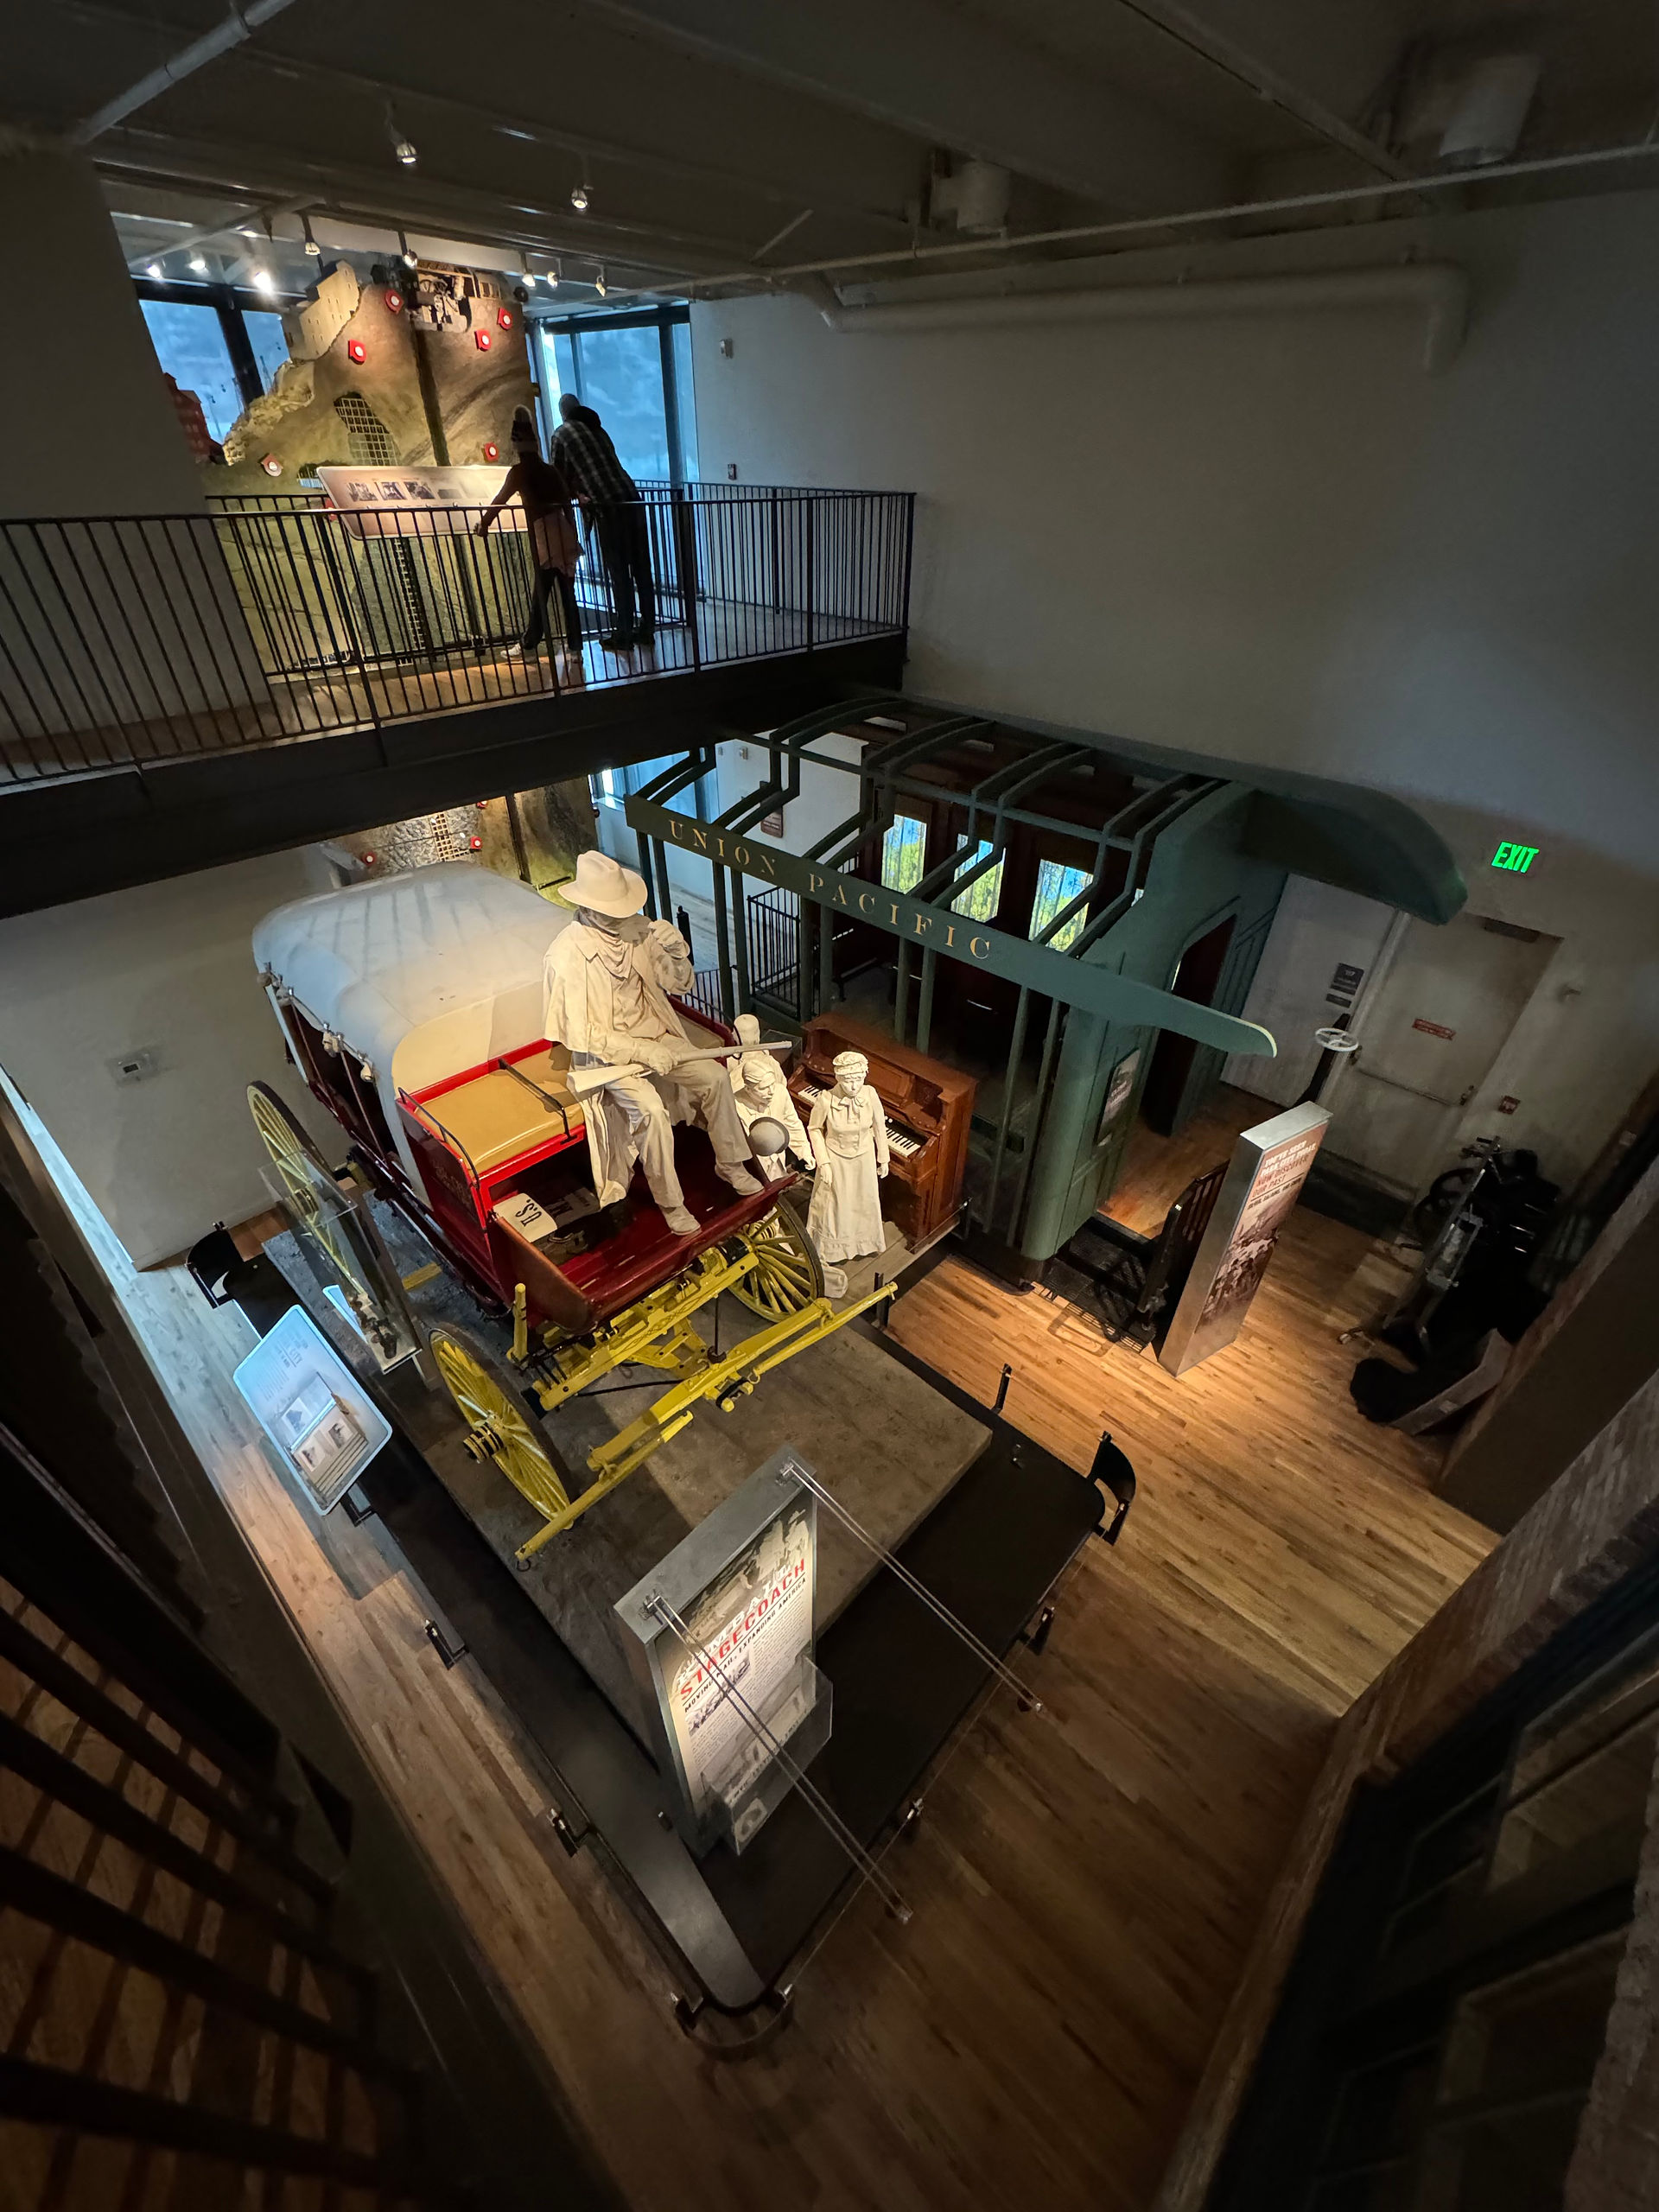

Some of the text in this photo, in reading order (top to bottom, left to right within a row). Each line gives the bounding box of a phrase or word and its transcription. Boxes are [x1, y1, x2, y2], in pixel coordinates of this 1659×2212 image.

[669, 819, 991, 960] UNION PACIFIC
[1491, 842, 1540, 873] EXIT
[515, 1198, 543, 1227] U.S.
[680, 1558, 805, 1700] STAGECOACH
[739, 1610, 776, 1654] EXPANDING
[779, 1578, 806, 1611] AMERICA
